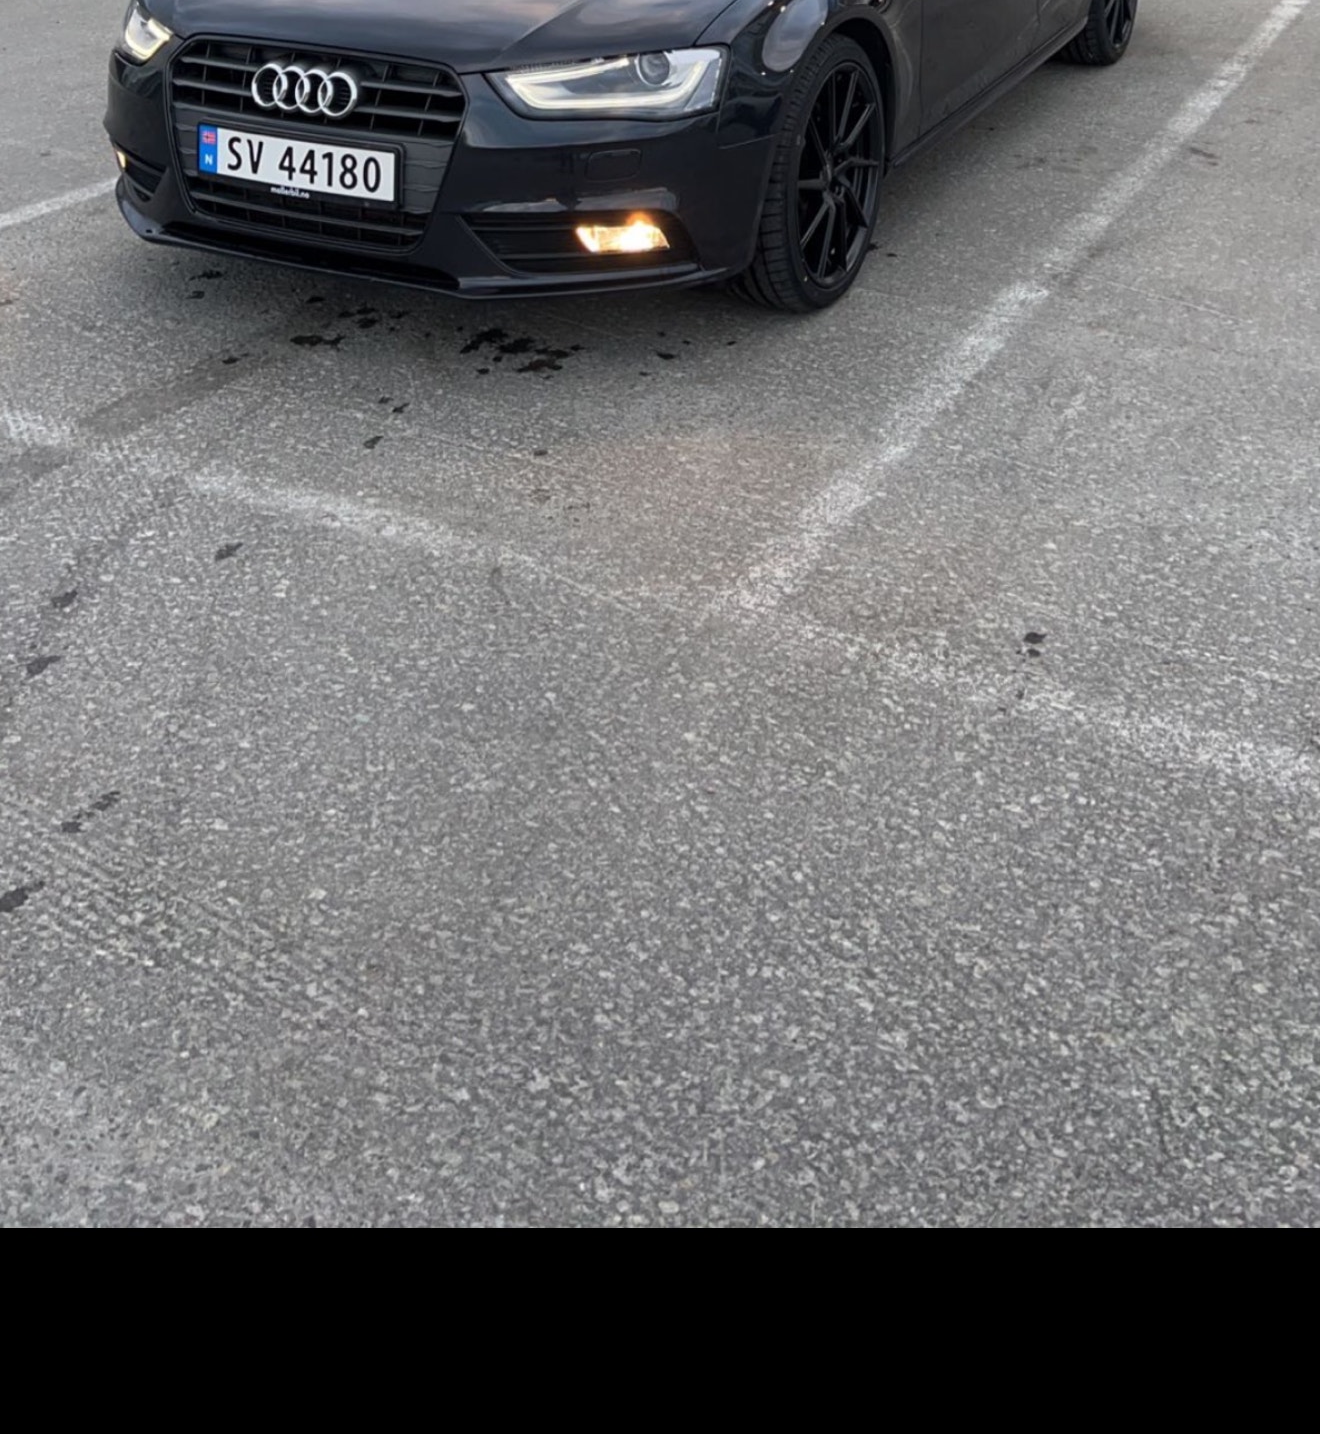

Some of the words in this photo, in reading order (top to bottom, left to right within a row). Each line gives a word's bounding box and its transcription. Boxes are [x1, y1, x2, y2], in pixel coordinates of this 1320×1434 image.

[205, 154, 213, 165] N
[227, 137, 263, 174] SV
[278, 146, 381, 193] 44180
